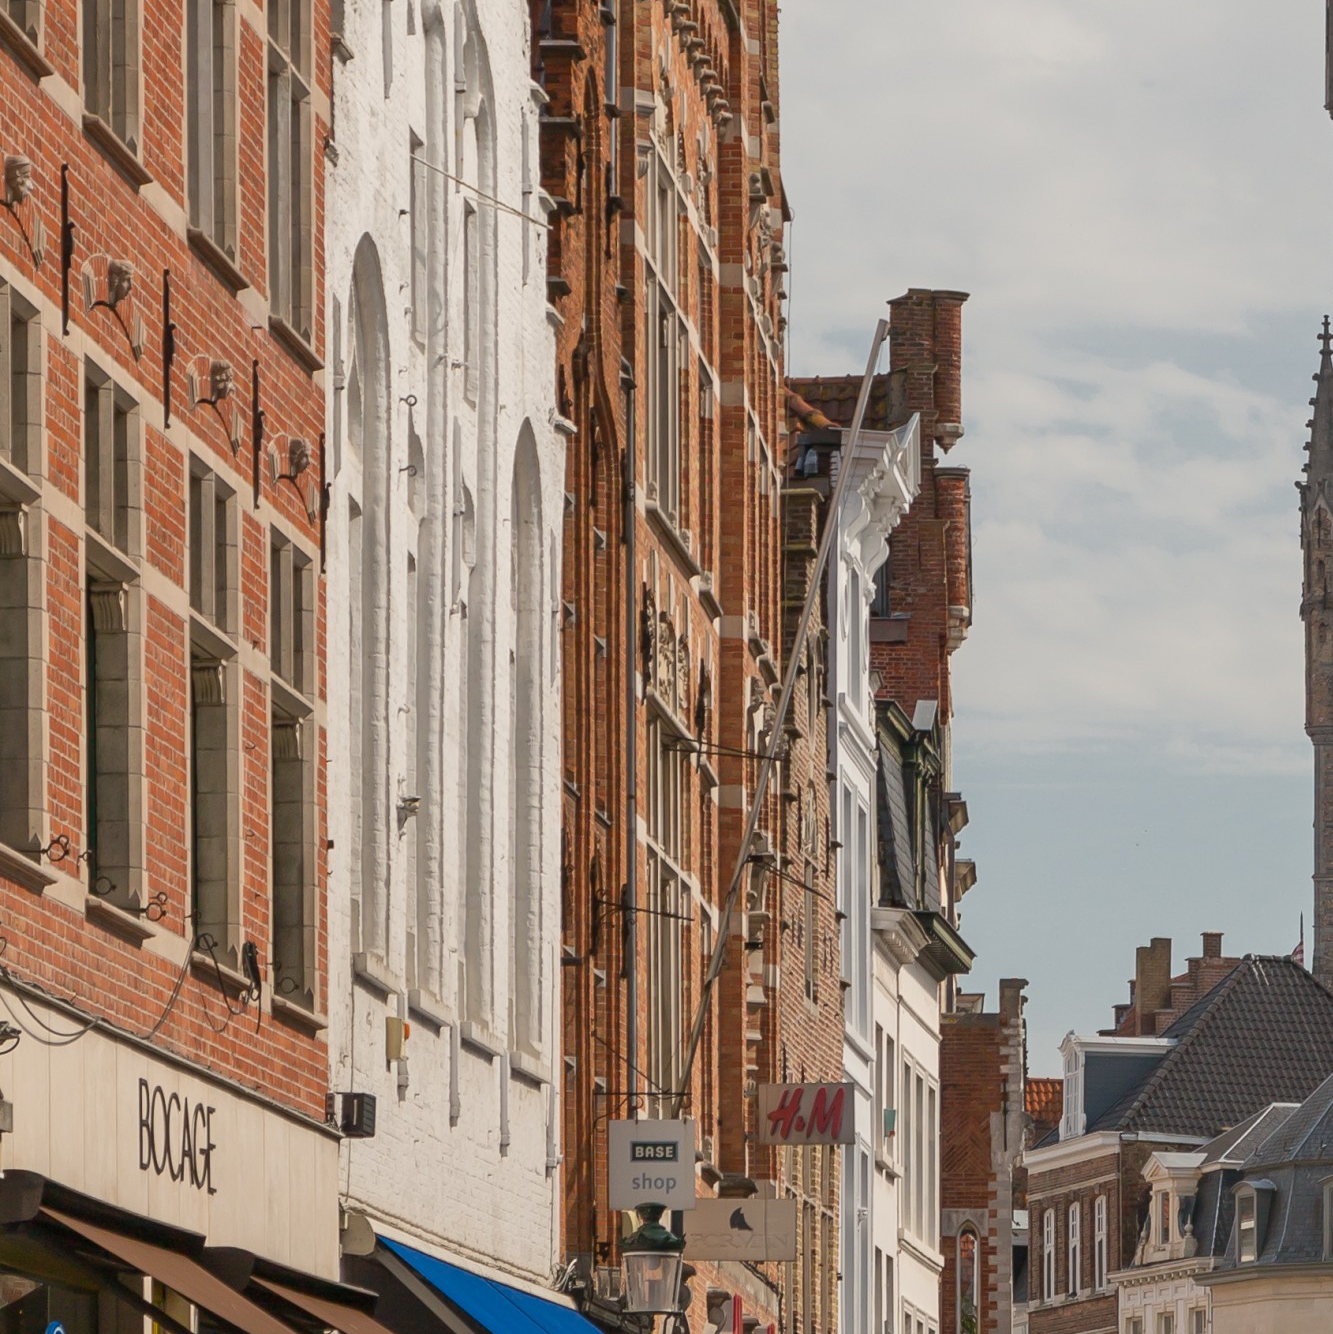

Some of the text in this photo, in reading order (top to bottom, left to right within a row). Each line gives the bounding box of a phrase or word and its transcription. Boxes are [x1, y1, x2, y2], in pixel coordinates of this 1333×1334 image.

[767, 1087, 845, 1140] H&M
[138, 1077, 217, 1196] BOCAGE
[635, 1146, 674, 1159] BASE
[632, 1173, 677, 1194] shop
